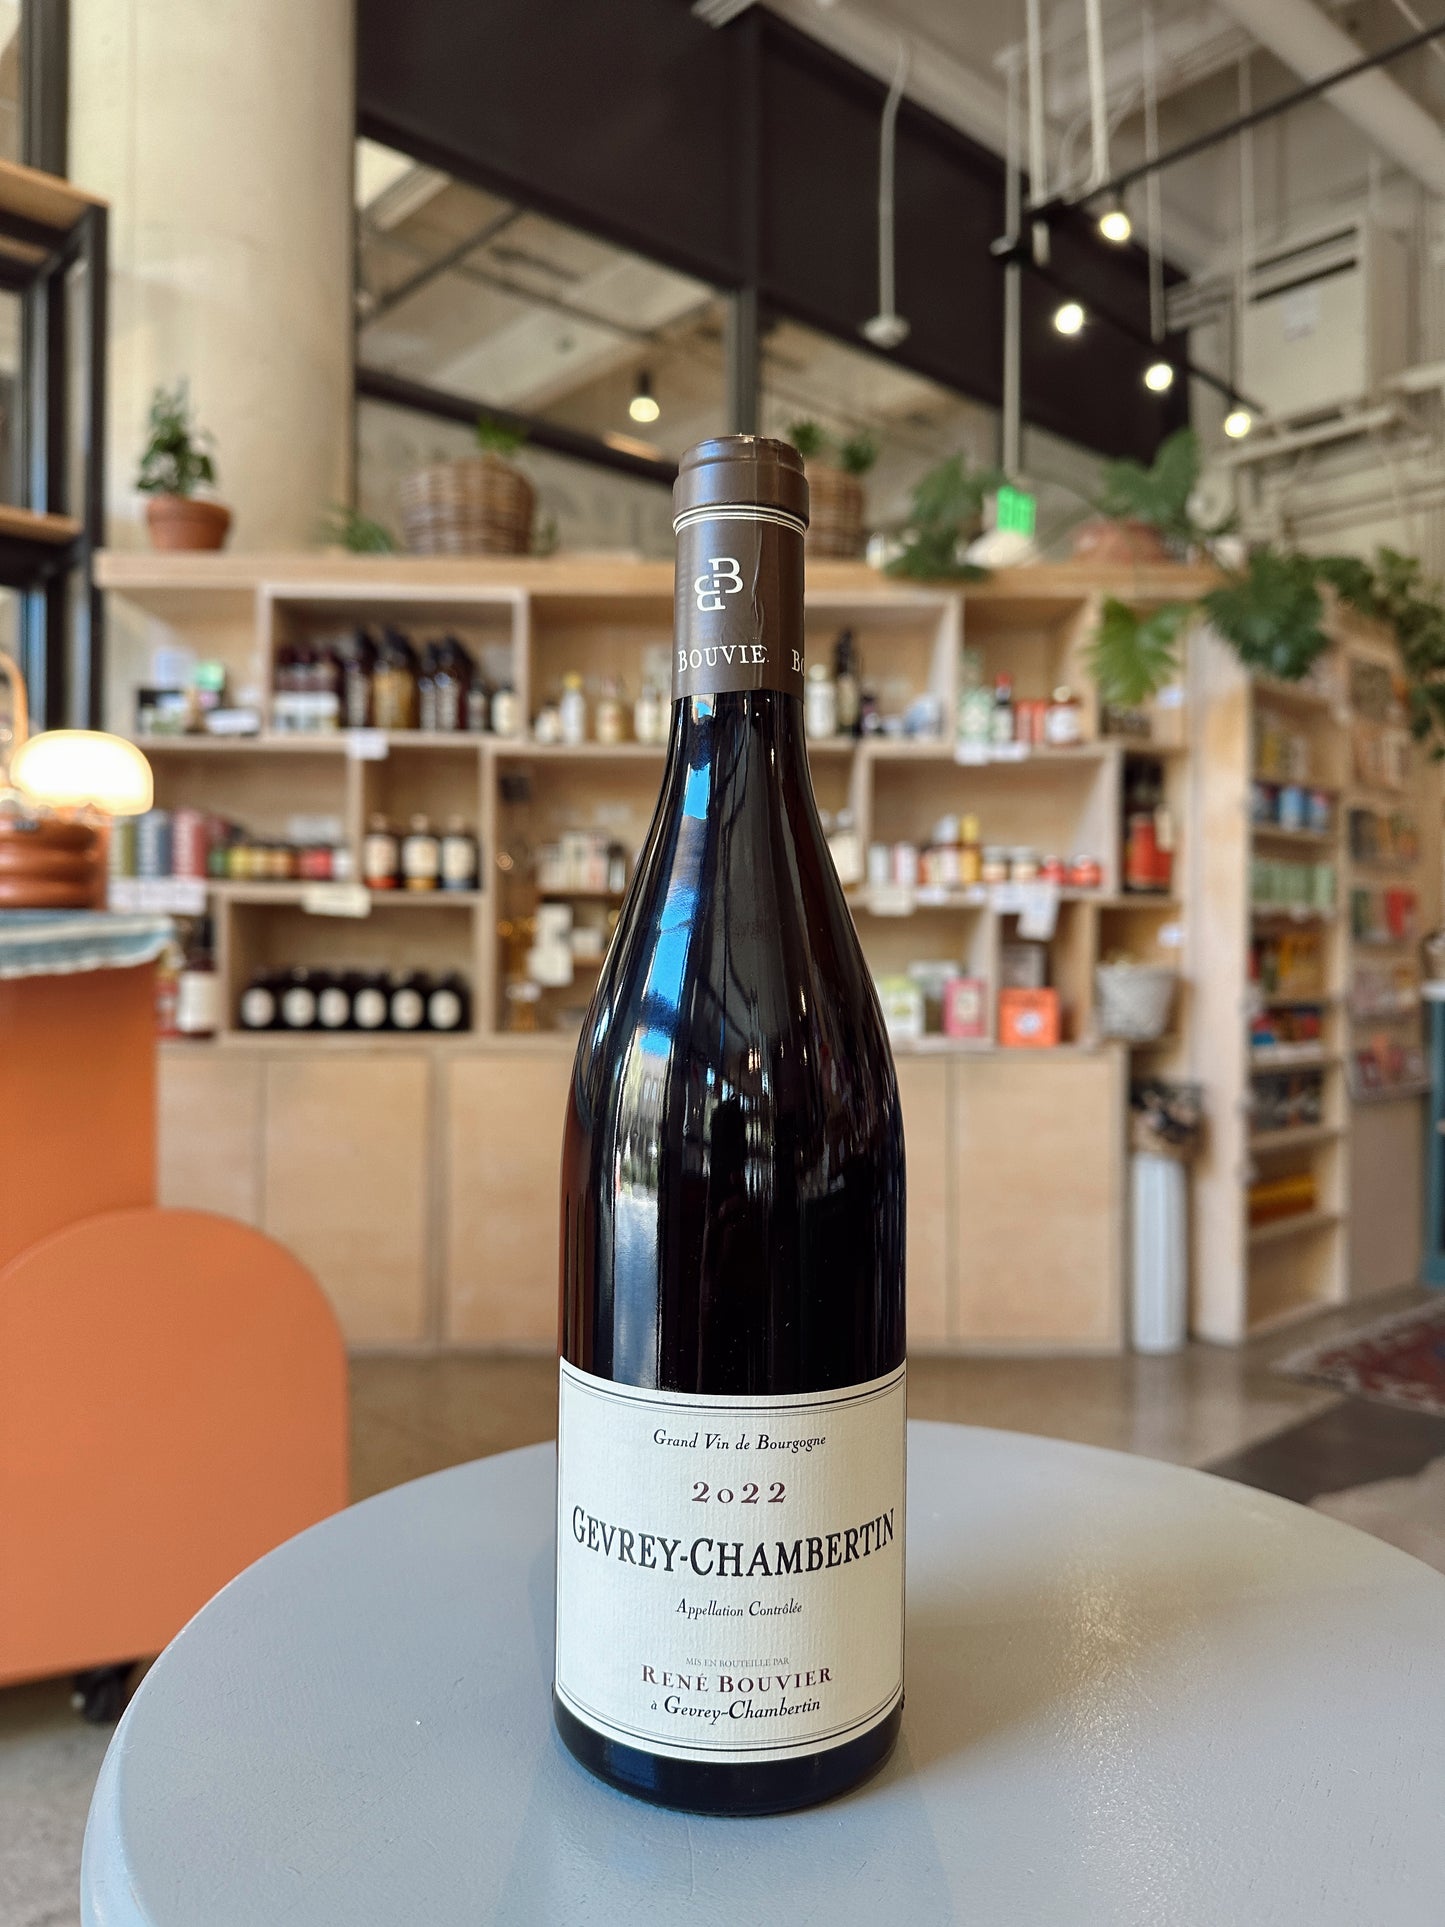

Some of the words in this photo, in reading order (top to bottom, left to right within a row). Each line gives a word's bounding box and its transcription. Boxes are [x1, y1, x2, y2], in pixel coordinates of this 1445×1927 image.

[678, 645, 769, 673] BOUVIE
[653, 1428, 698, 1448] Grand
[704, 1433, 729, 1450] Vin
[735, 1433, 750, 1450] de
[755, 1434, 826, 1454] Bourgogne
[691, 1481, 786, 1504] 2022
[572, 1504, 895, 1577] GEVREY-CHAMBERTIN
[676, 1597, 744, 1620] Appellation
[748, 1597, 802, 1616] Contrôlée
[686, 1657, 702, 1666] MIS
[704, 1659, 717, 1667] EN
[773, 1657, 790, 1666] PAR
[641, 1664, 709, 1692] RENÉ
[717, 1667, 833, 1694] BOUVIER
[651, 1700, 657, 1710] à
[664, 1695, 821, 1726] Gevrey-Chambertin
